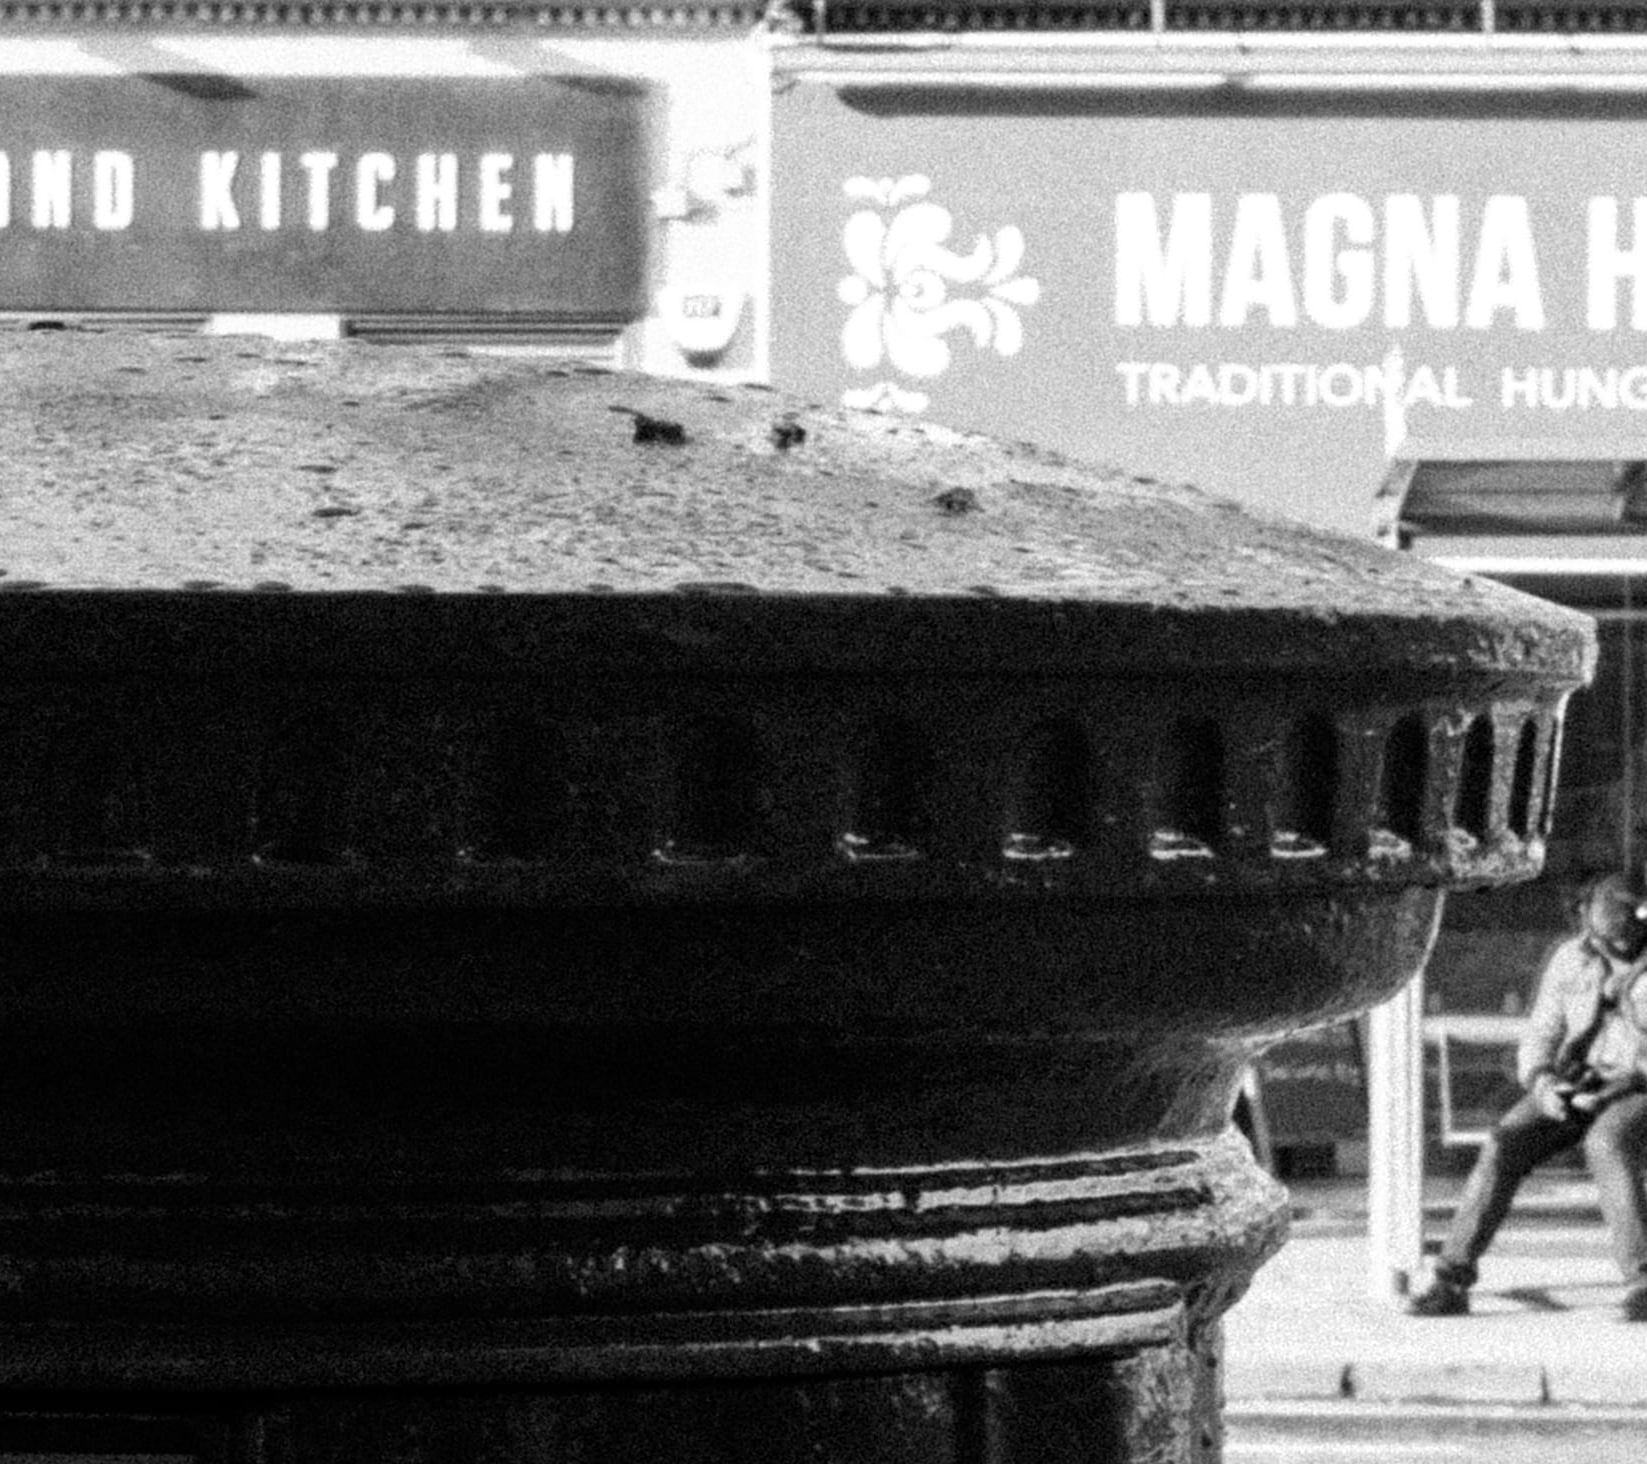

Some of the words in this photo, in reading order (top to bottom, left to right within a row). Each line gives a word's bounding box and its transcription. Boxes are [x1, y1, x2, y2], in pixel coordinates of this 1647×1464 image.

[196, 149, 576, 234] KITCHEN
[1113, 190, 1547, 332] MAGNA
[1115, 360, 1474, 409] TRADITIONAL
